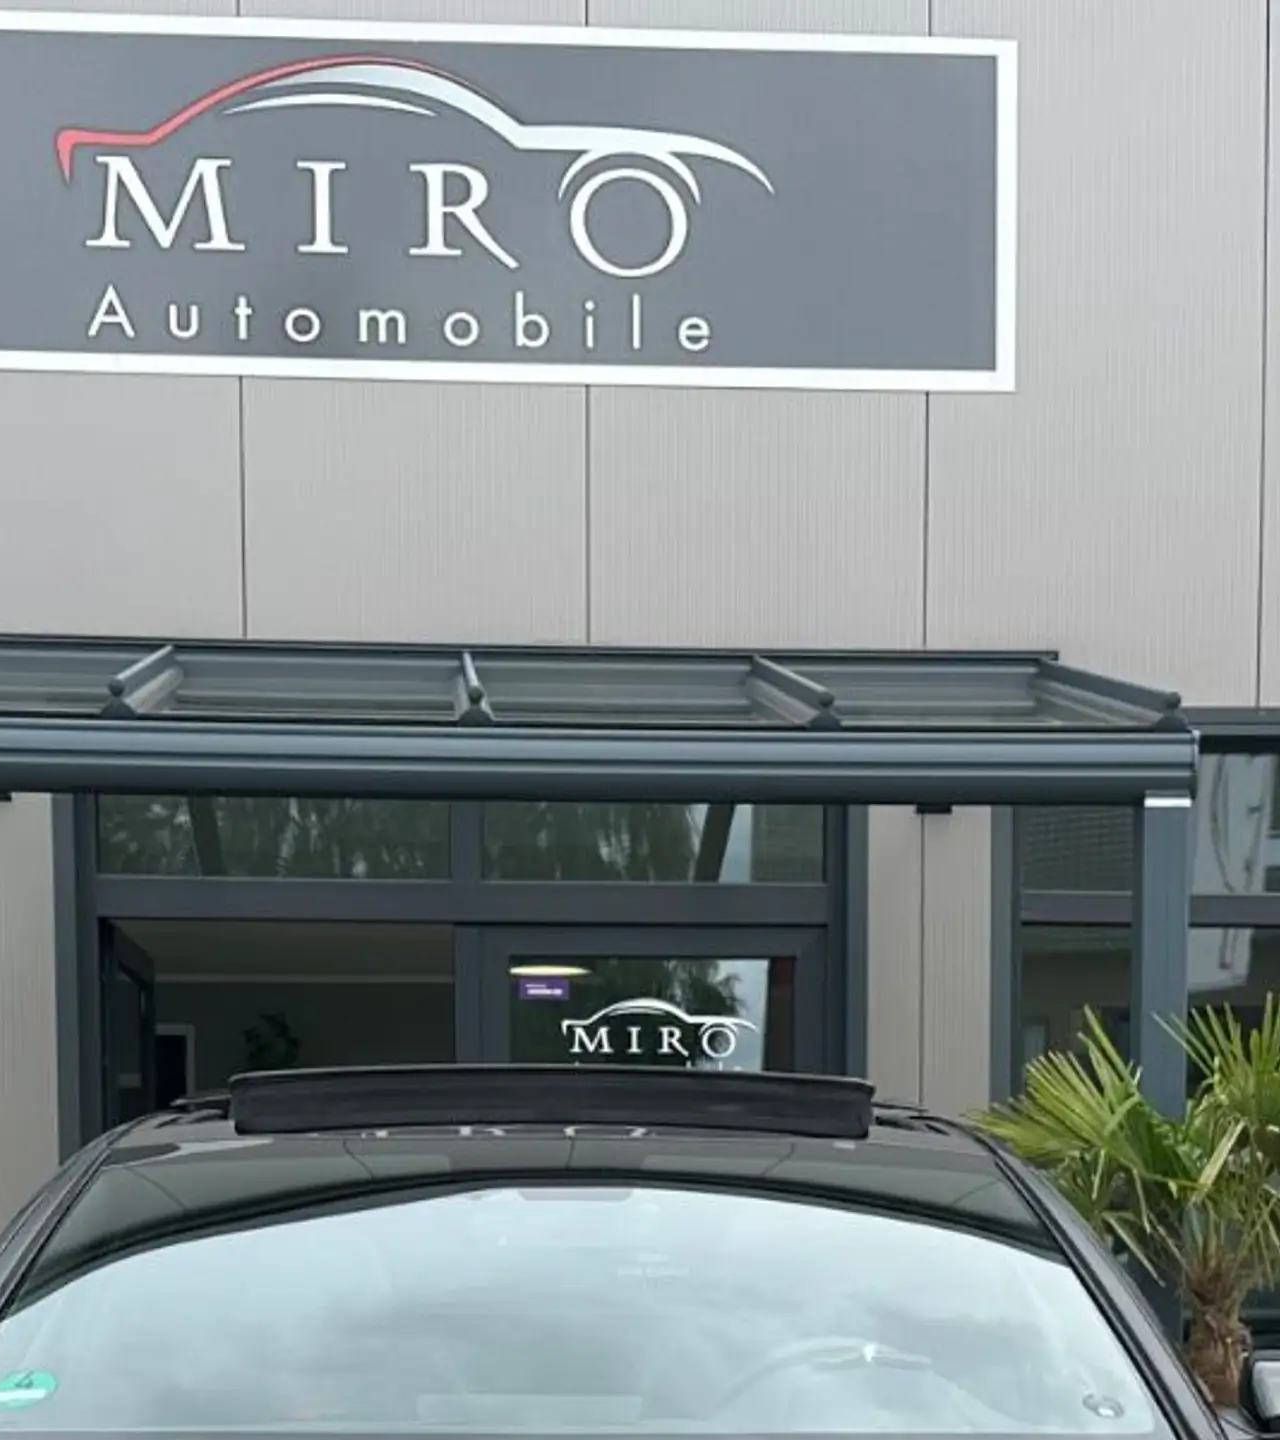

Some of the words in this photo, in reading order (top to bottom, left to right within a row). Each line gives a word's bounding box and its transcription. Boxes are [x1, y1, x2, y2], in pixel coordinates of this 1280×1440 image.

[85, 155, 688, 278] MIRO
[88, 285, 711, 351] Automobile
[570, 1026, 737, 1059] MIRO
